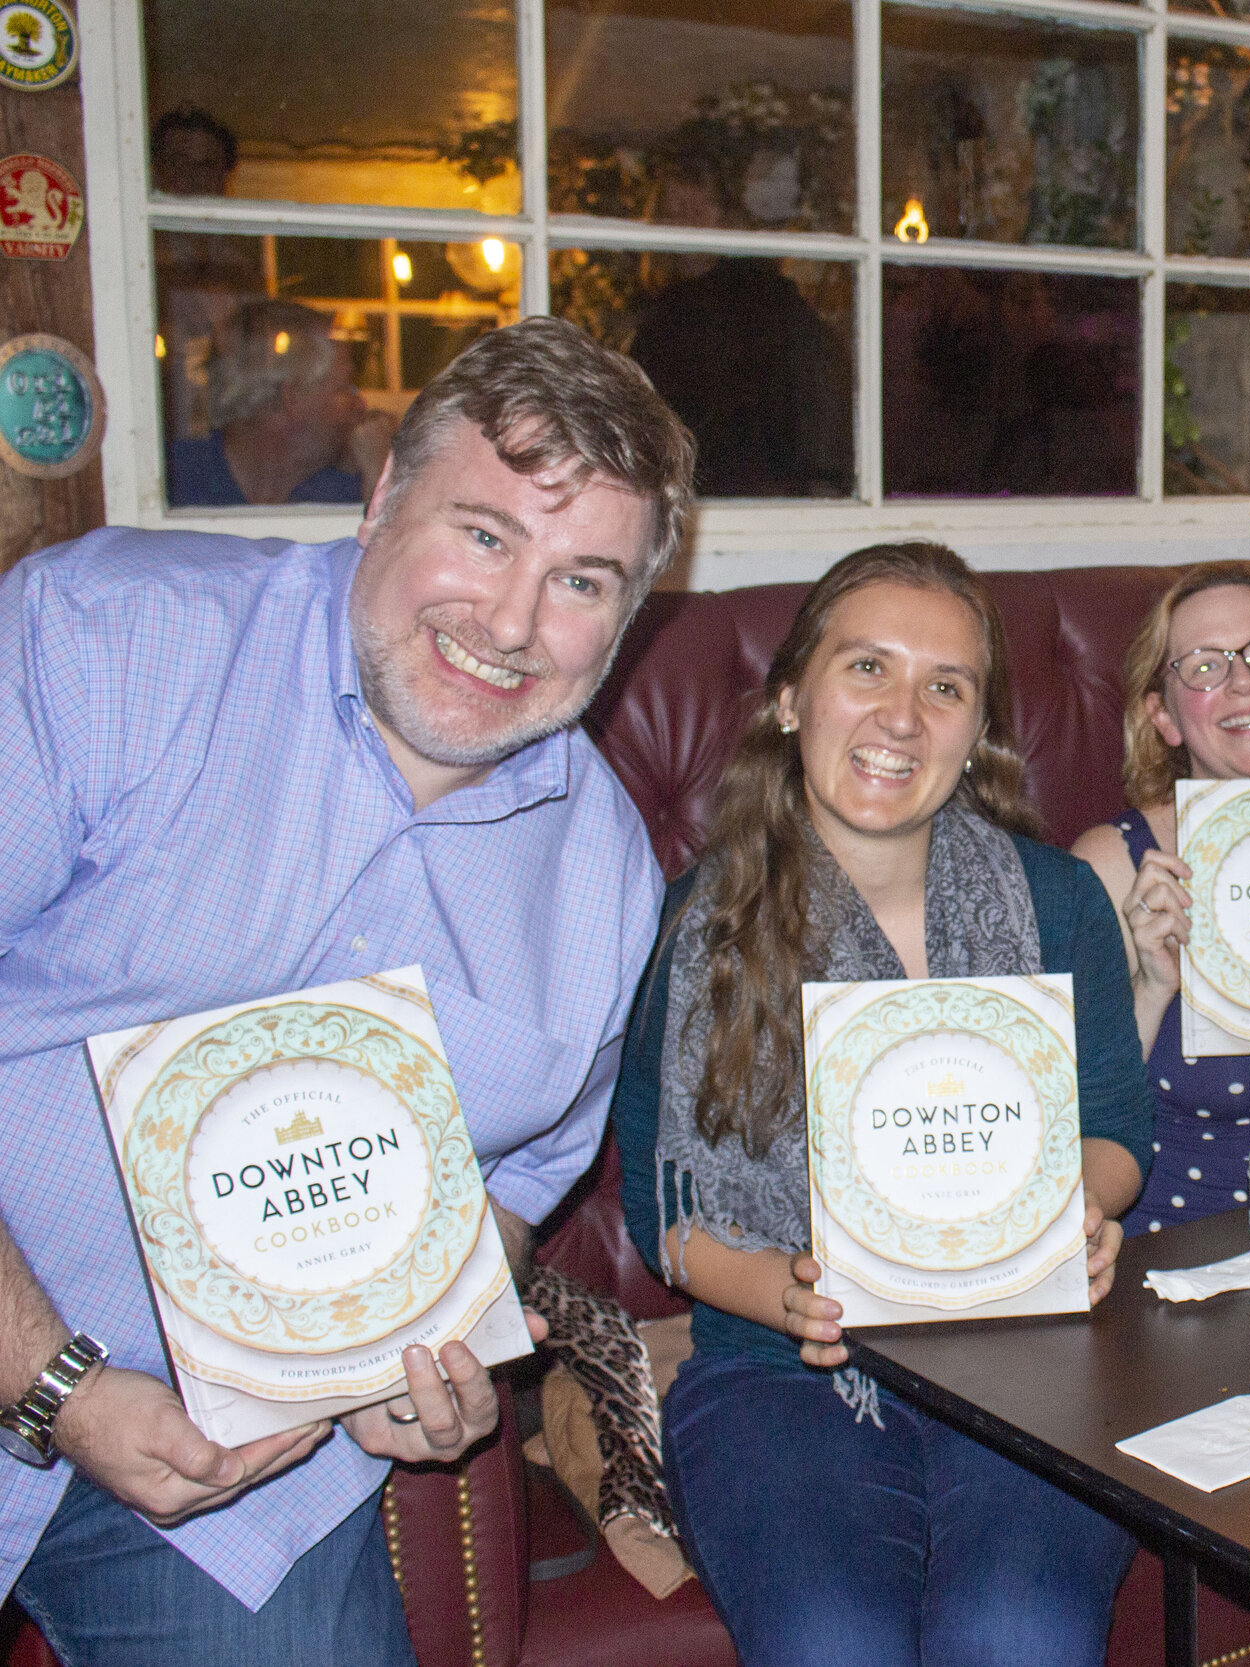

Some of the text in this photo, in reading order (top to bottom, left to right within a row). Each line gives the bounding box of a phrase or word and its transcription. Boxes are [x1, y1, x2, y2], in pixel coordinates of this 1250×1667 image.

[0, 60, 58, 82] AYMAKER
[904, 1057, 984, 1076] THE OFFICIAL
[241, 1090, 342, 1126] THE OFFICIAL
[872, 1101, 1021, 1129] DOWNTON
[902, 1130, 993, 1156] ABBEY
[212, 1128, 399, 1198] DOWNTON
[891, 1160, 1007, 1179] COOKBOOK
[262, 1169, 370, 1222] ABBEY
[955, 1189, 981, 1198] GRAY
[254, 1201, 397, 1252] COOKBOOK
[296, 1242, 373, 1270] ANNIE GRAY
[950, 1278, 987, 1288] GARETH
[989, 1267, 1019, 1282] NEAME
[281, 1366, 346, 1378] FOREWORD
[348, 1364, 356, 1373] by
[359, 1346, 403, 1368] GARETH
